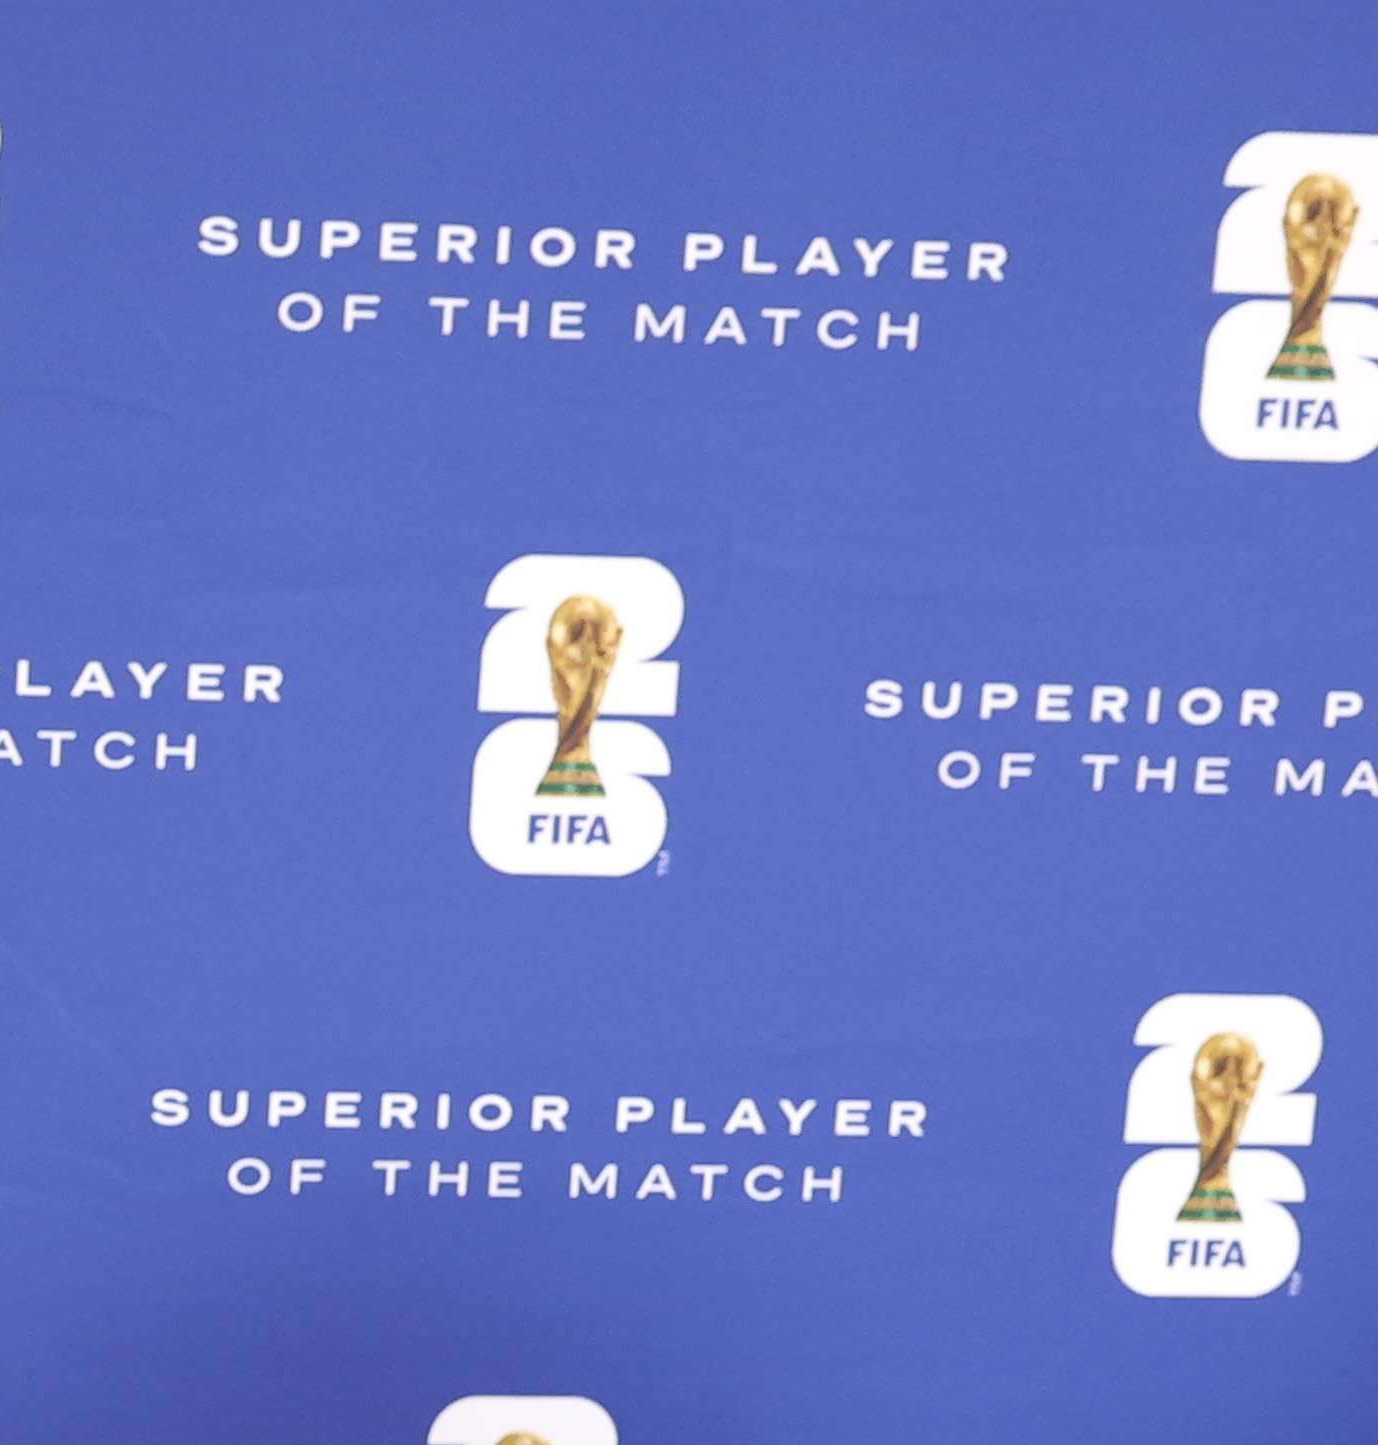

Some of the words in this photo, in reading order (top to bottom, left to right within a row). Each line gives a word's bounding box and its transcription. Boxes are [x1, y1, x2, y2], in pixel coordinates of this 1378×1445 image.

[196, 214, 637, 271] SUPERIOR
[681, 231, 1010, 284] PLAYER
[276, 290, 383, 334] OF
[426, 295, 588, 342] THE
[632, 302, 921, 353] MATCH
[1256, 398, 1338, 430] FIFA
[863, 677, 1281, 729] SUPERIOR
[936, 748, 1038, 791] OF
[1079, 752, 1232, 796] THE
[527, 814, 611, 845] FIFA
[149, 1087, 571, 1134] SUPERIOR
[614, 1095, 928, 1139] PLAYER
[226, 1155, 328, 1197] OF
[370, 1158, 525, 1200] THE
[567, 1161, 844, 1204] MATCH
[1167, 1239, 1246, 1267] FIFA
